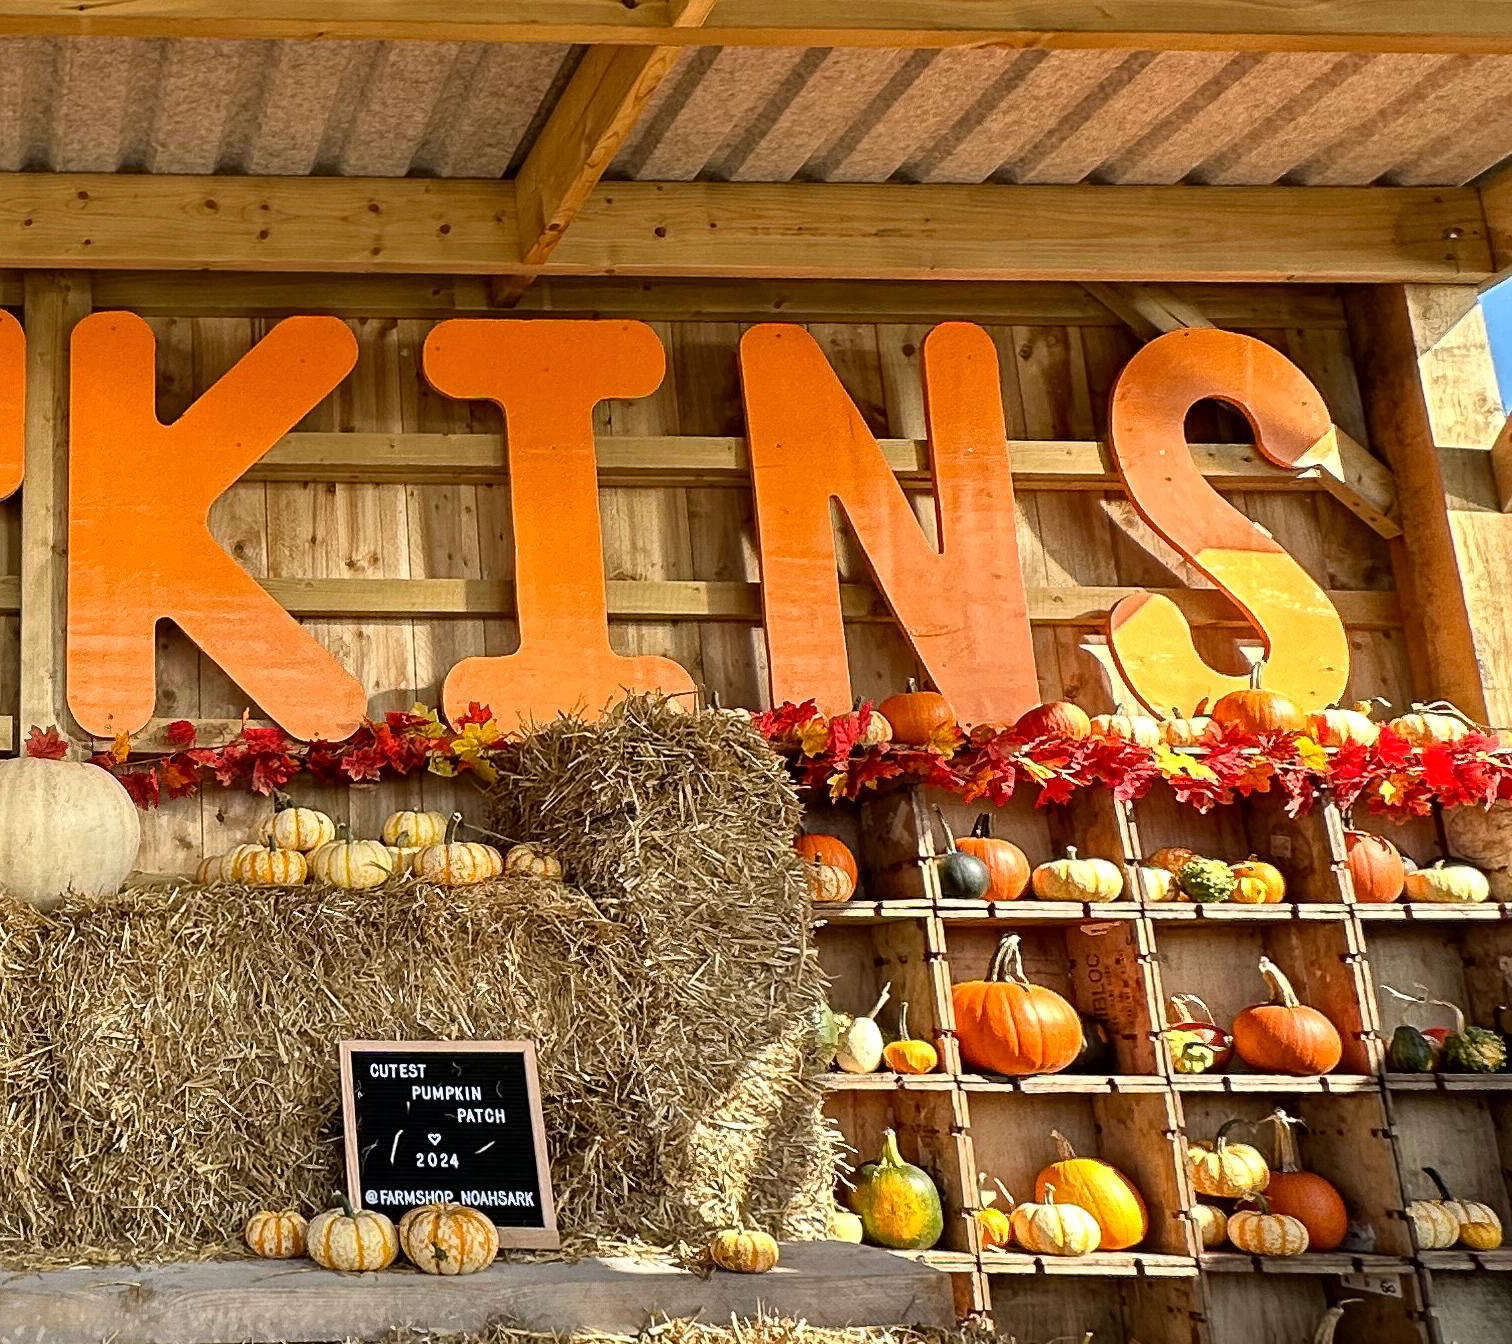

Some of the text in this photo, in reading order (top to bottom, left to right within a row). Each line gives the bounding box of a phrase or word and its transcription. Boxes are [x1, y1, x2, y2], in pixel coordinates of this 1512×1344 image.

[369, 1063, 427, 1079] CUTEST
[411, 1085, 482, 1101] PUMPKIN
[456, 1108, 506, 1124] PATCH
[415, 1152, 460, 1169] 2024
